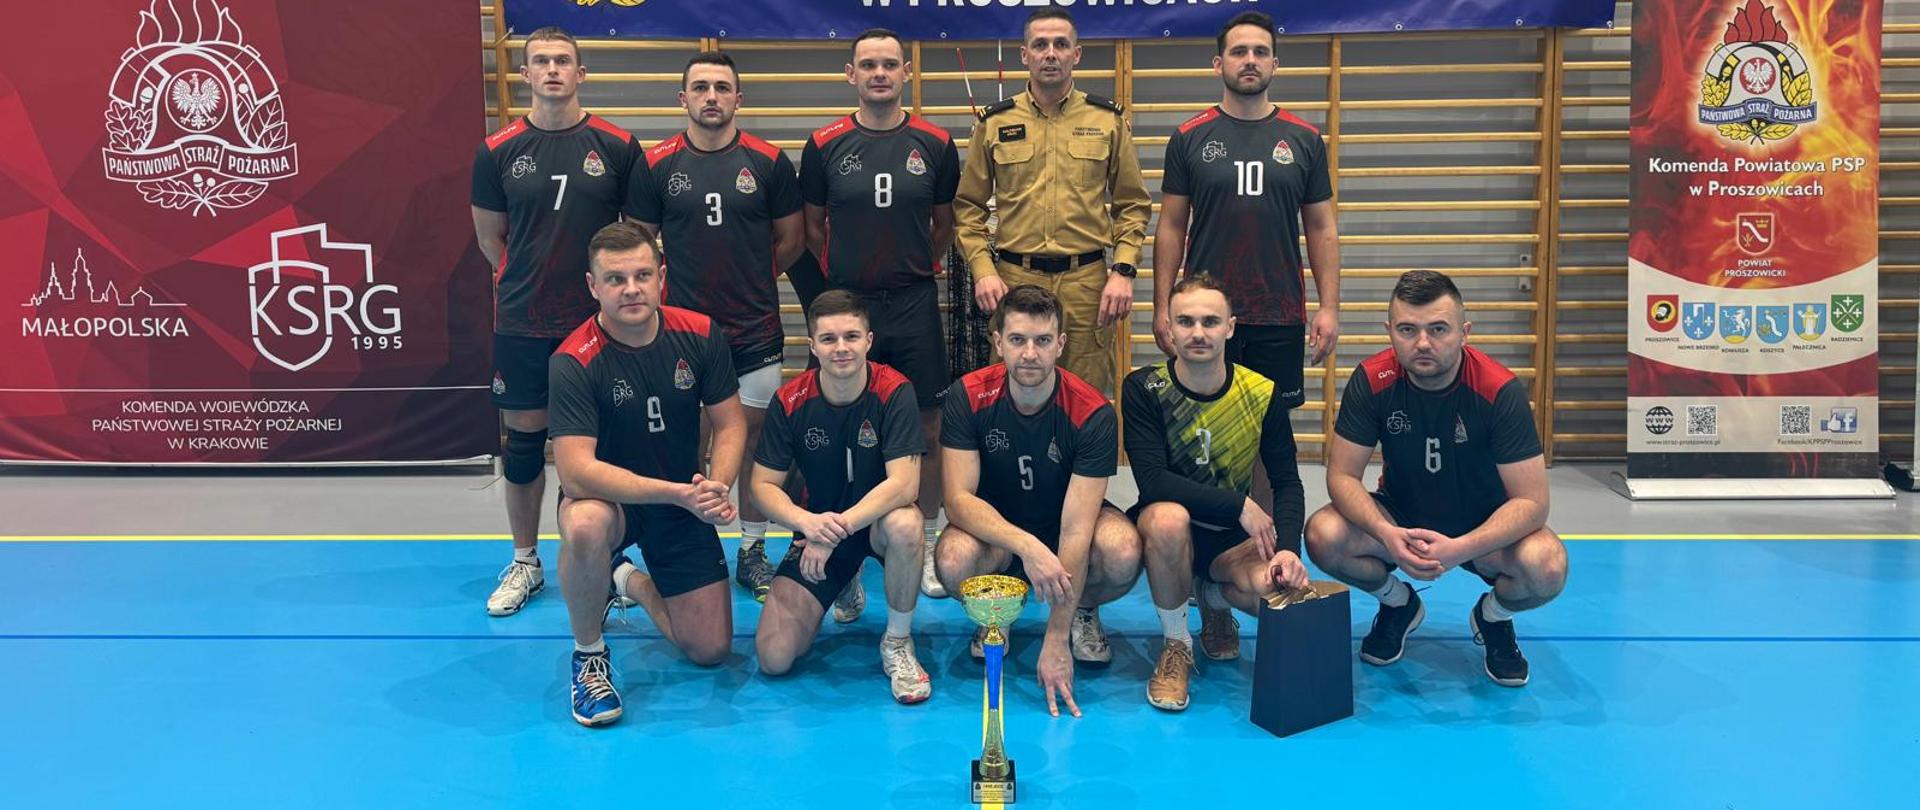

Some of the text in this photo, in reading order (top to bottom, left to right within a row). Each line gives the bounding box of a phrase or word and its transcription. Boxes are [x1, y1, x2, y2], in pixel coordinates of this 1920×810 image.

[1701, 103, 1813, 121] PAŃSTWOWA STRAŻ POŻARNA
[108, 146, 290, 176] PAŃSTWOWA STRAŻ POŻARNA
[1648, 157, 1866, 173] Komenda Powiatowa PSP
[551, 174, 568, 211] 7
[874, 172, 893, 208] 8
[1233, 161, 1264, 196] 10
[1689, 180, 1824, 197] w Proszowicach
[704, 192, 723, 227] 3
[1725, 269, 1787, 277] PROSZOWICKI
[1738, 259, 1772, 267] POWIAT
[248, 284, 402, 336] KSRG
[22, 317, 189, 338] MAŁOPOLSKA
[351, 335, 403, 350] 1995
[122, 398, 310, 413] KOMENDA WOJEWÓDZKA
[646, 396, 666, 433] 9
[92, 416, 342, 432] PAŃSTWOWEJ STRAŻY POŻARNEJ
[167, 437, 269, 450] W KRAKOWIE
[1195, 428, 1211, 465] 3
[1425, 436, 1442, 474] 6
[846, 446, 854, 483] 1
[1017, 454, 1034, 490] 5
